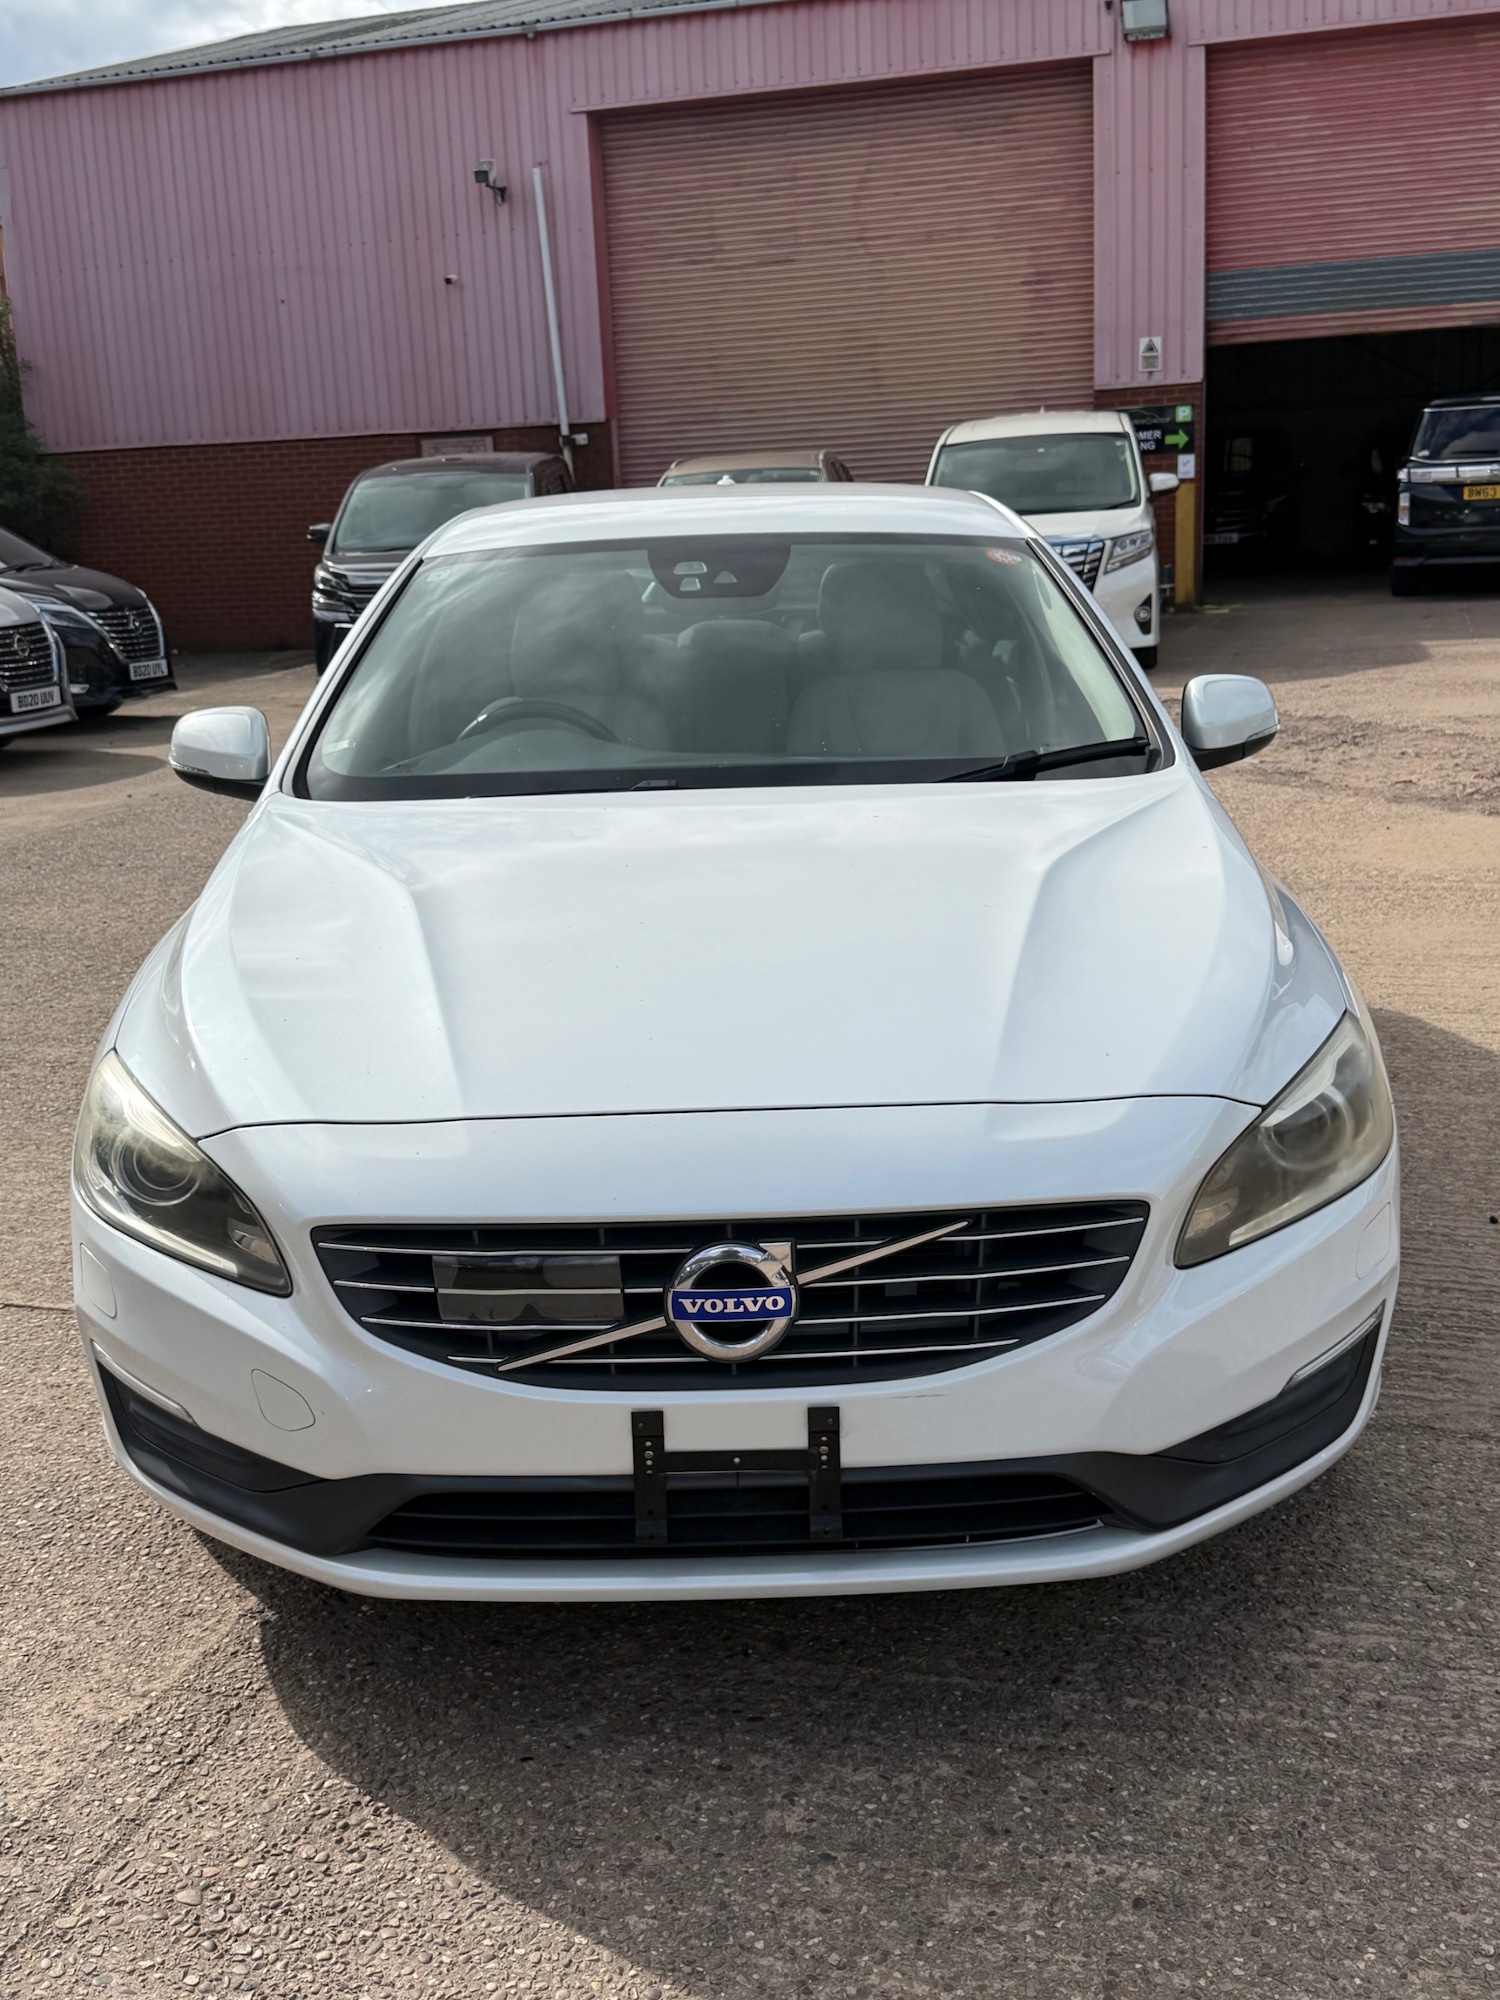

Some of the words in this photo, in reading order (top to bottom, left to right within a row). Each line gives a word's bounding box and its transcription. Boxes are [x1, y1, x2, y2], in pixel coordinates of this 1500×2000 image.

[1179, 406, 1188, 421] P
[1137, 429, 1162, 440] MER
[1139, 441, 1156, 451] NG
[132, 663, 152, 678] BD20
[17, 693, 39, 709] BD20
[678, 1295, 785, 1314] VOLVO
